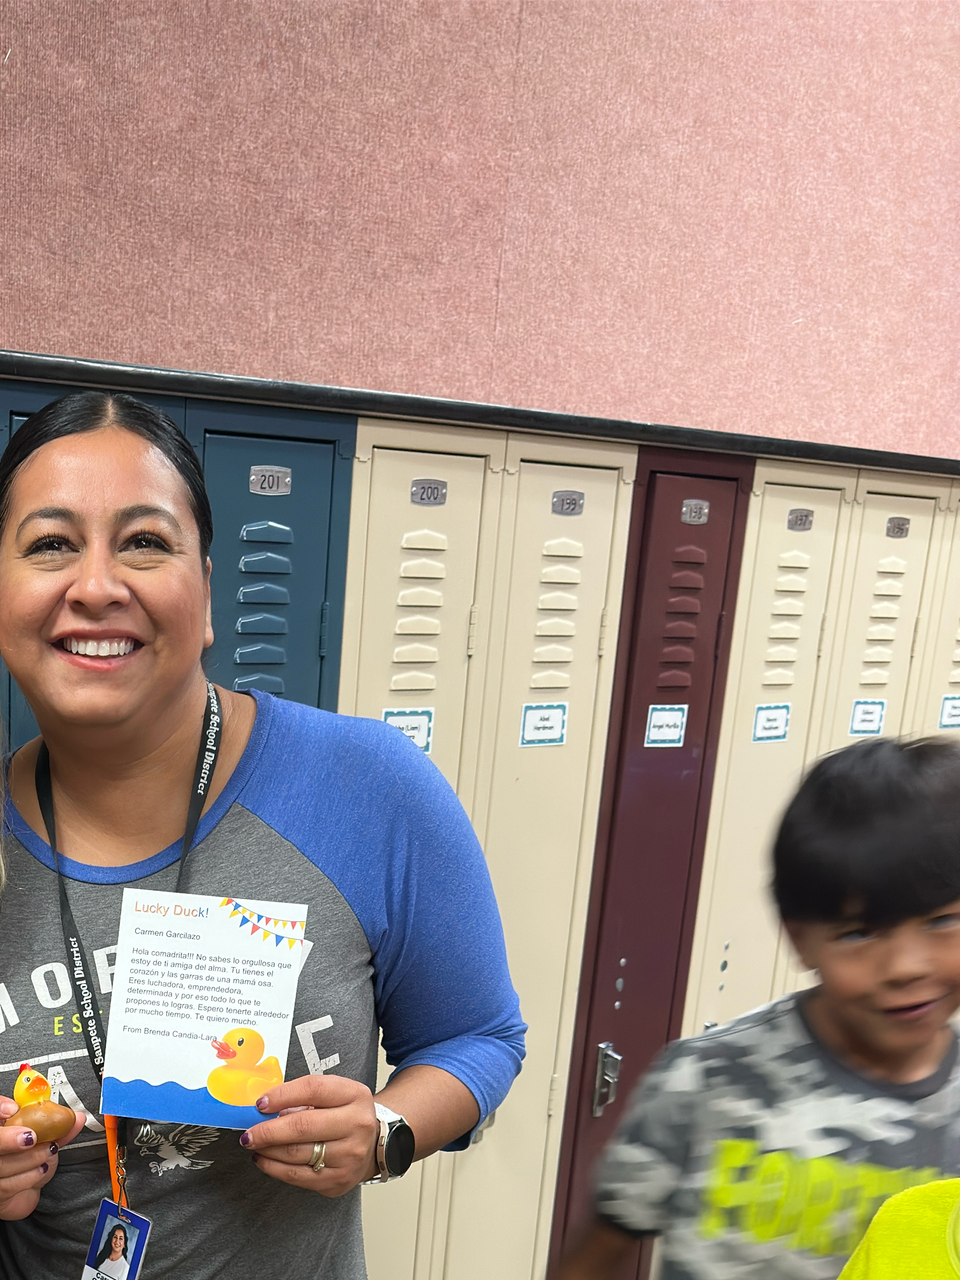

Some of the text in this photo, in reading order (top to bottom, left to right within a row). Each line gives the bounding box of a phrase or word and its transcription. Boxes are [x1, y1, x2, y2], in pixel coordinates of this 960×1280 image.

[260, 474, 280, 490] 201
[420, 486, 439, 501] 200
[561, 498, 576, 512] 199
[206, 714, 220, 750] School
[197, 751, 215, 796] District
[134, 901, 209, 918] Lucky Duck!
[134, 927, 200, 940] Carmen Garcilazo
[130, 958, 150, 966] estoy
[170, 962, 192, 970] amiga
[231, 966, 240, 974] Tu
[242, 968, 264, 976] tienes
[266, 970, 274, 978] el
[132, 947, 149, 956] Hola
[151, 950, 194, 960] comadrita!!!
[209, 956, 231, 964] sabes
[242, 959, 276, 968] orgullosa
[278, 962, 292, 970] que
[128, 976, 244, 996] Eres luchadora, emprendedora,
[130, 968, 158, 976] corazón
[167, 970, 178, 978] las
[180, 973, 203, 981] garras
[206, 974, 214, 982] de
[232, 978, 256, 986] mamá
[258, 980, 274, 988] osa.
[69, 936, 104, 1066] Sanpete School District
[127, 986, 172, 998] determinada
[174, 992, 180, 1000] y
[195, 994, 208, 1002] eso
[210, 995, 227, 1003] todo
[238, 998, 252, 1006] que
[124, 1006, 258, 1026] por mucho tiempo. Te quiero mucho.
[126, 997, 290, 1019] propones lo logras. Espero tenerte alrededor
[122, 1025, 218, 1041] From Brenda Candia-Lara
